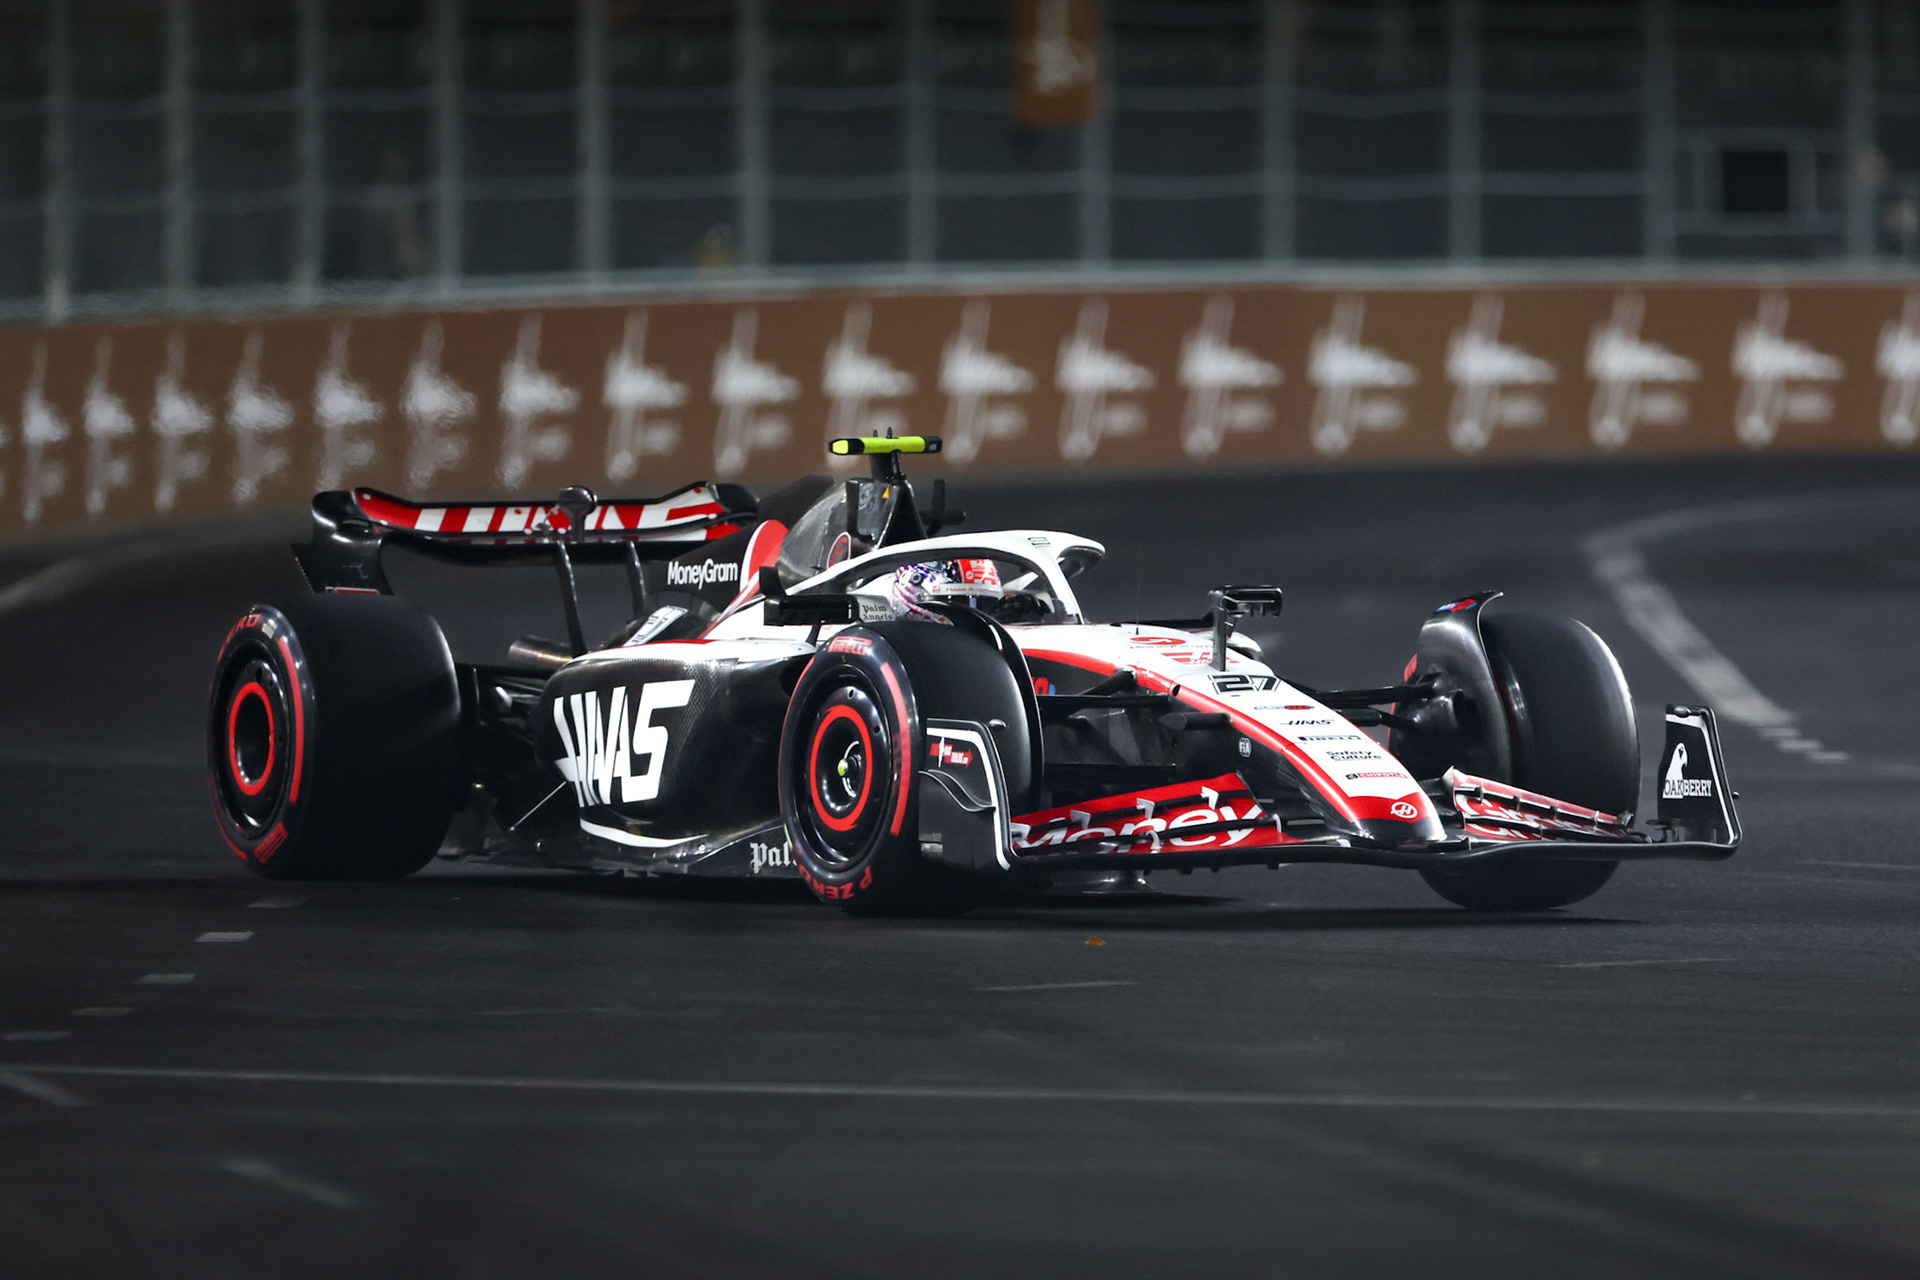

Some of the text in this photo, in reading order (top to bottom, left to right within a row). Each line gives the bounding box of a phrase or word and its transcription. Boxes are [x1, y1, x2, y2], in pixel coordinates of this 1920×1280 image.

[667, 558, 739, 590] MoneyGram
[862, 604, 887, 614] Palm
[1207, 674, 1281, 695] 27
[554, 679, 696, 808] HAAS
[1664, 779, 1712, 797] OAKBERRY
[749, 842, 797, 875] Pal
